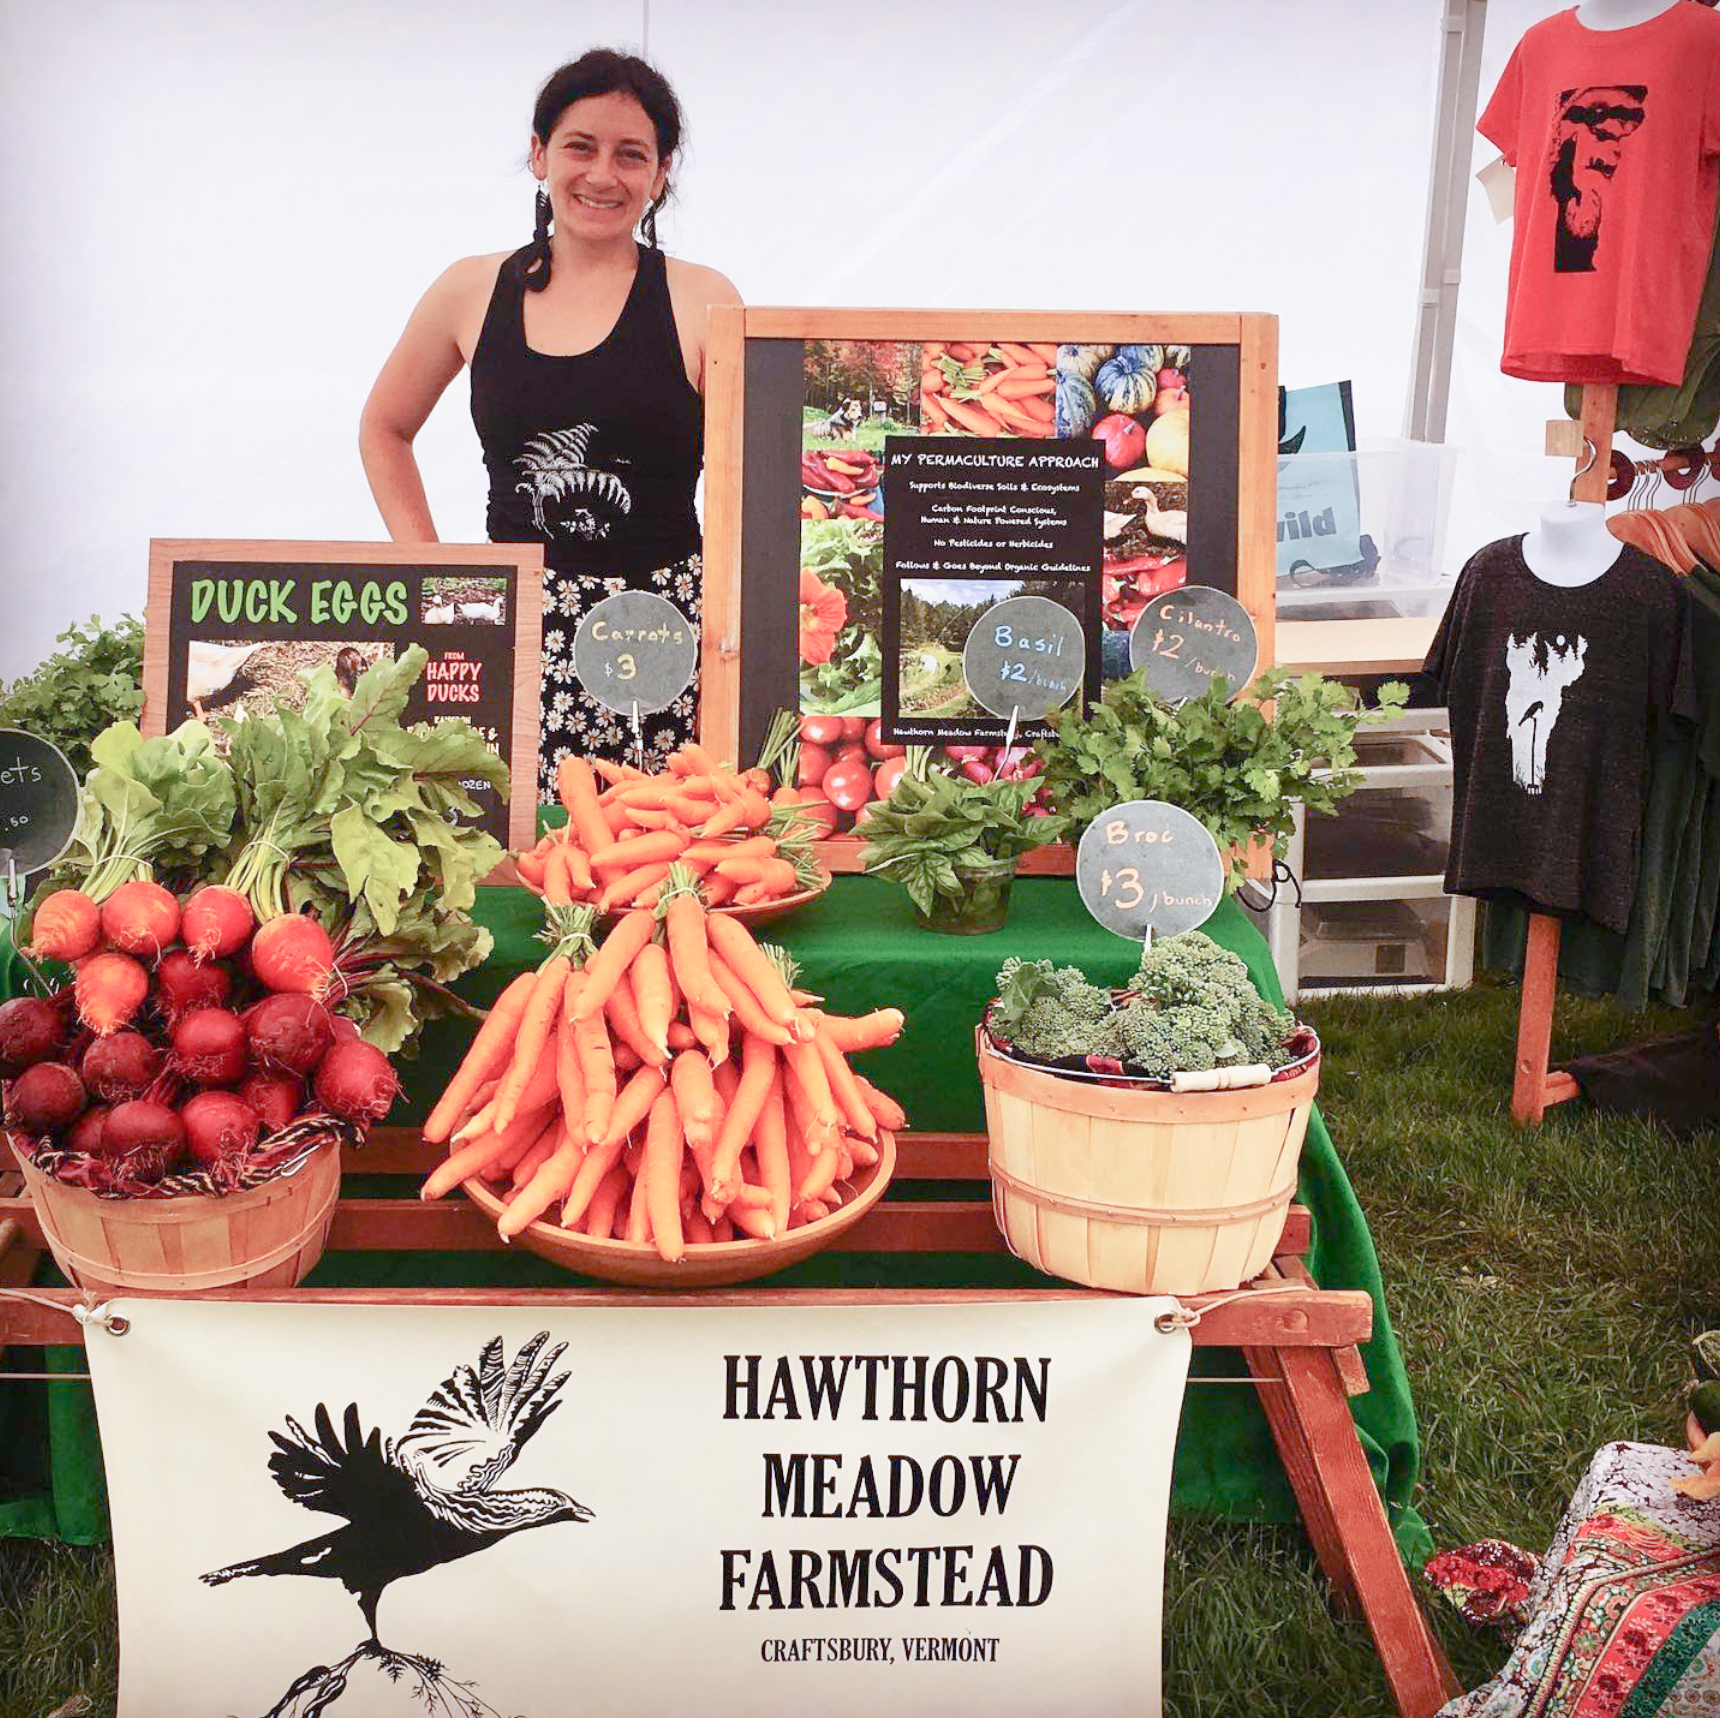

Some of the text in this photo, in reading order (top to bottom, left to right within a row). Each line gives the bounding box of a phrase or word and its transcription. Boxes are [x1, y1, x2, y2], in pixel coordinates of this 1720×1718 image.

[891, 454, 1098, 468] MY PERMACULTURE APPROACH
[909, 481, 1079, 494] Supports Biodiverse Soils & Ecosystems
[932, 504, 1056, 517] Carbon Footprint Conscious,
[953, 515, 960, 524] &
[964, 516, 991, 524] Nature
[994, 517, 1032, 525] Powered
[1034, 518, 1067, 529] Systems
[949, 539, 992, 547] Pesticides
[1009, 540, 1053, 548] Herbicides
[896, 561, 1090, 574] Follows & Goes Beyond Organic Guidelines
[191, 579, 408, 625] DUCK EGGS
[1160, 604, 1240, 642] Cilantro
[591, 621, 683, 645] Carrots
[994, 625, 1064, 657] Basil
[444, 652, 465, 660] FROM
[427, 662, 482, 681] HAPPY
[427, 684, 480, 703] DUCKS
[488, 727, 498, 741] &
[893, 728, 934, 736] Hawthorn
[937, 728, 971, 736] Meadow
[0, 756, 42, 785] ets
[458, 779, 491, 791] OZEN
[1105, 820, 1176, 846] Broc
[723, 1356, 1051, 1422] HAWTHORN
[762, 1454, 1021, 1517] MEADOW
[720, 1545, 1053, 1610] FARMSTEAD
[762, 1638, 999, 1664] CRAFTSBURY, VERMONT
